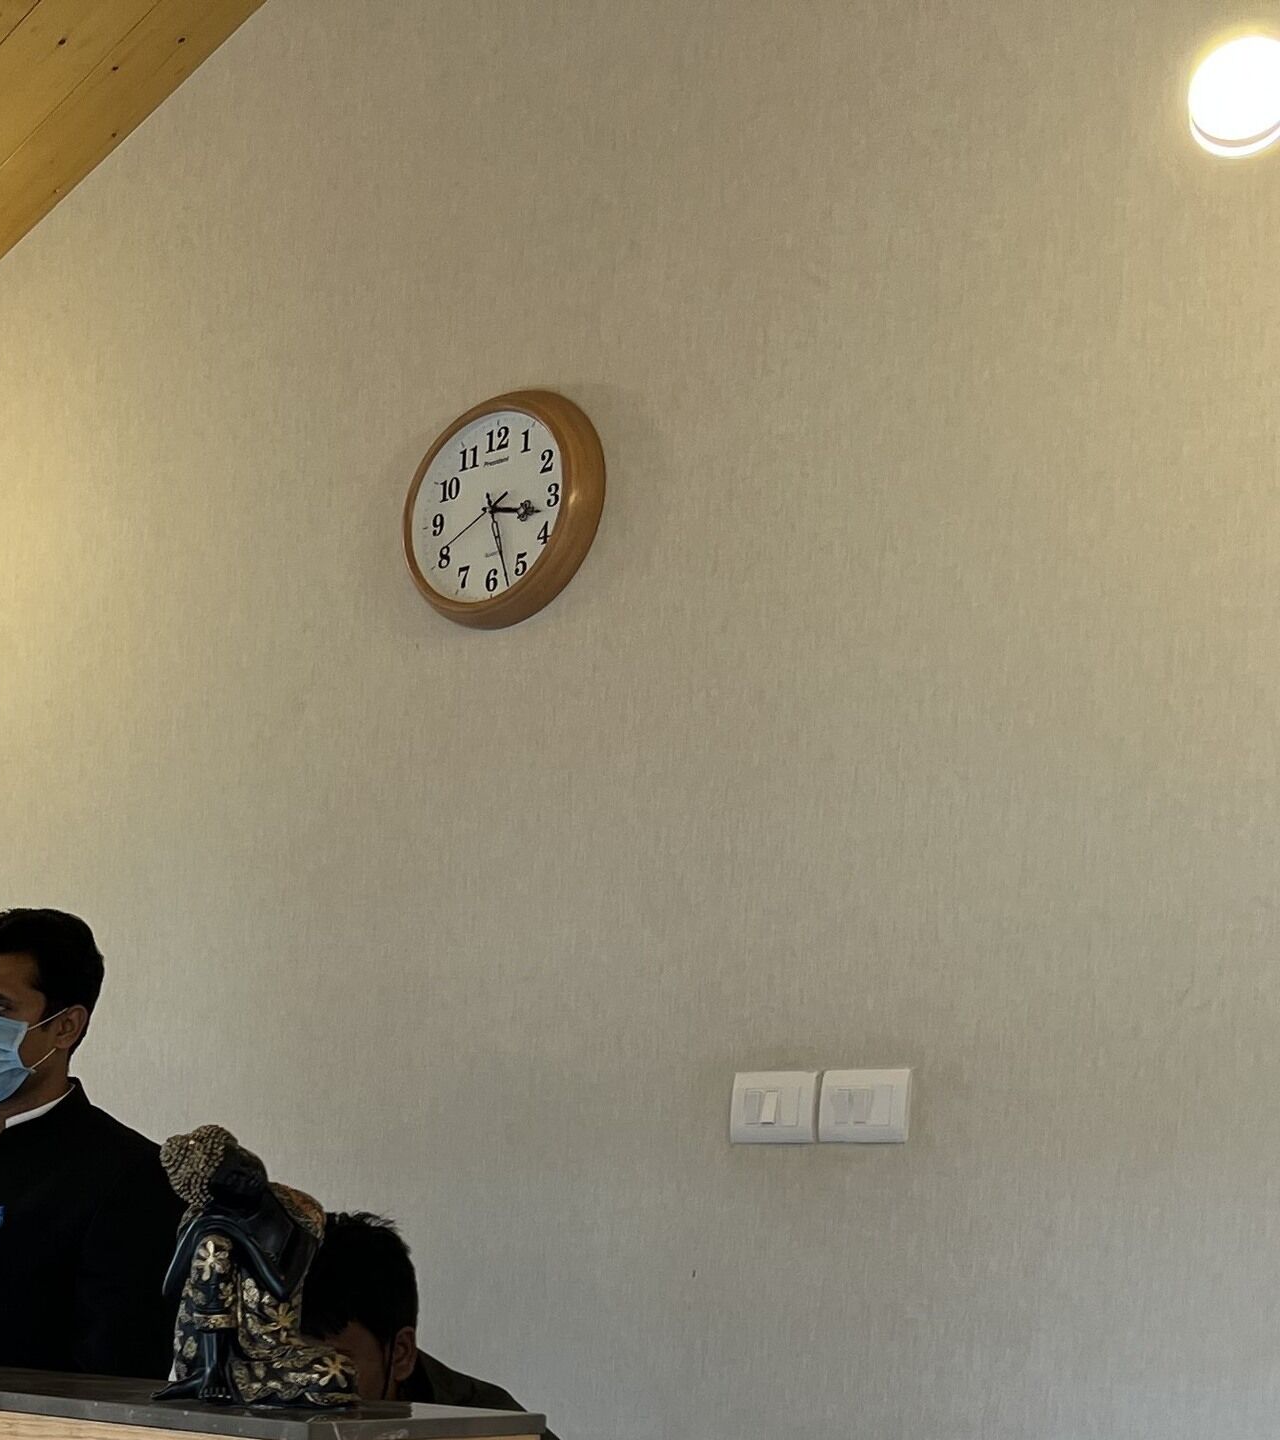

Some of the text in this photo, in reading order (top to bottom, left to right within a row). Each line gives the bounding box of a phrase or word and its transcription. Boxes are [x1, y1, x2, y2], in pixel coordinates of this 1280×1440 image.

[485, 426, 510, 454] 12
[520, 429, 532, 453] 1
[458, 445, 479, 472] 11
[539, 449, 554, 474] 2
[439, 476, 461, 503] 10
[546, 483, 560, 507] 3
[432, 513, 444, 536] 9
[536, 520, 552, 545] 4
[438, 544, 450, 569] 8
[514, 552, 527, 577] 5
[457, 565, 470, 589] 7
[485, 569, 498, 592] 6
